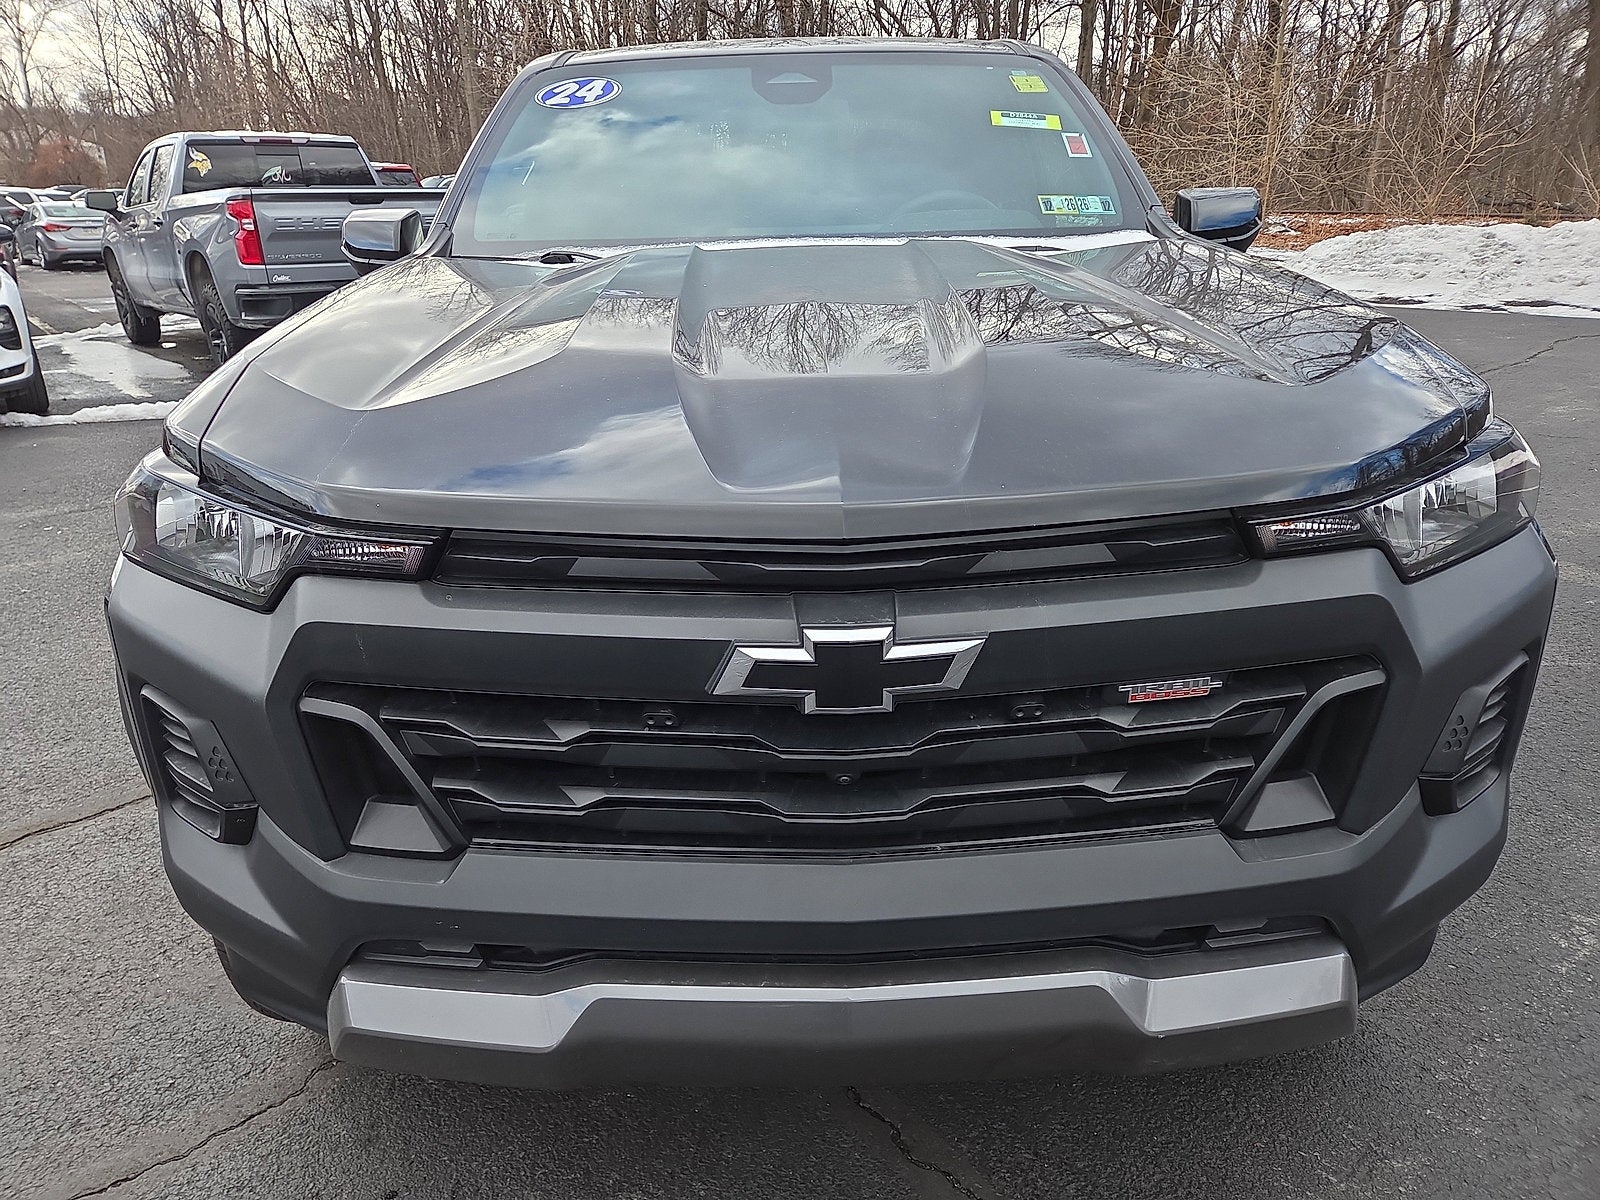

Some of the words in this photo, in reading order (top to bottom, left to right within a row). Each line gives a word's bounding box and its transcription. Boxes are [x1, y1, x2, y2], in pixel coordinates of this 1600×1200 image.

[544, 79, 608, 105] 24
[1064, 198, 1076, 211] 26
[1077, 198, 1089, 211] 26
[1128, 687, 1210, 703] BOSS
